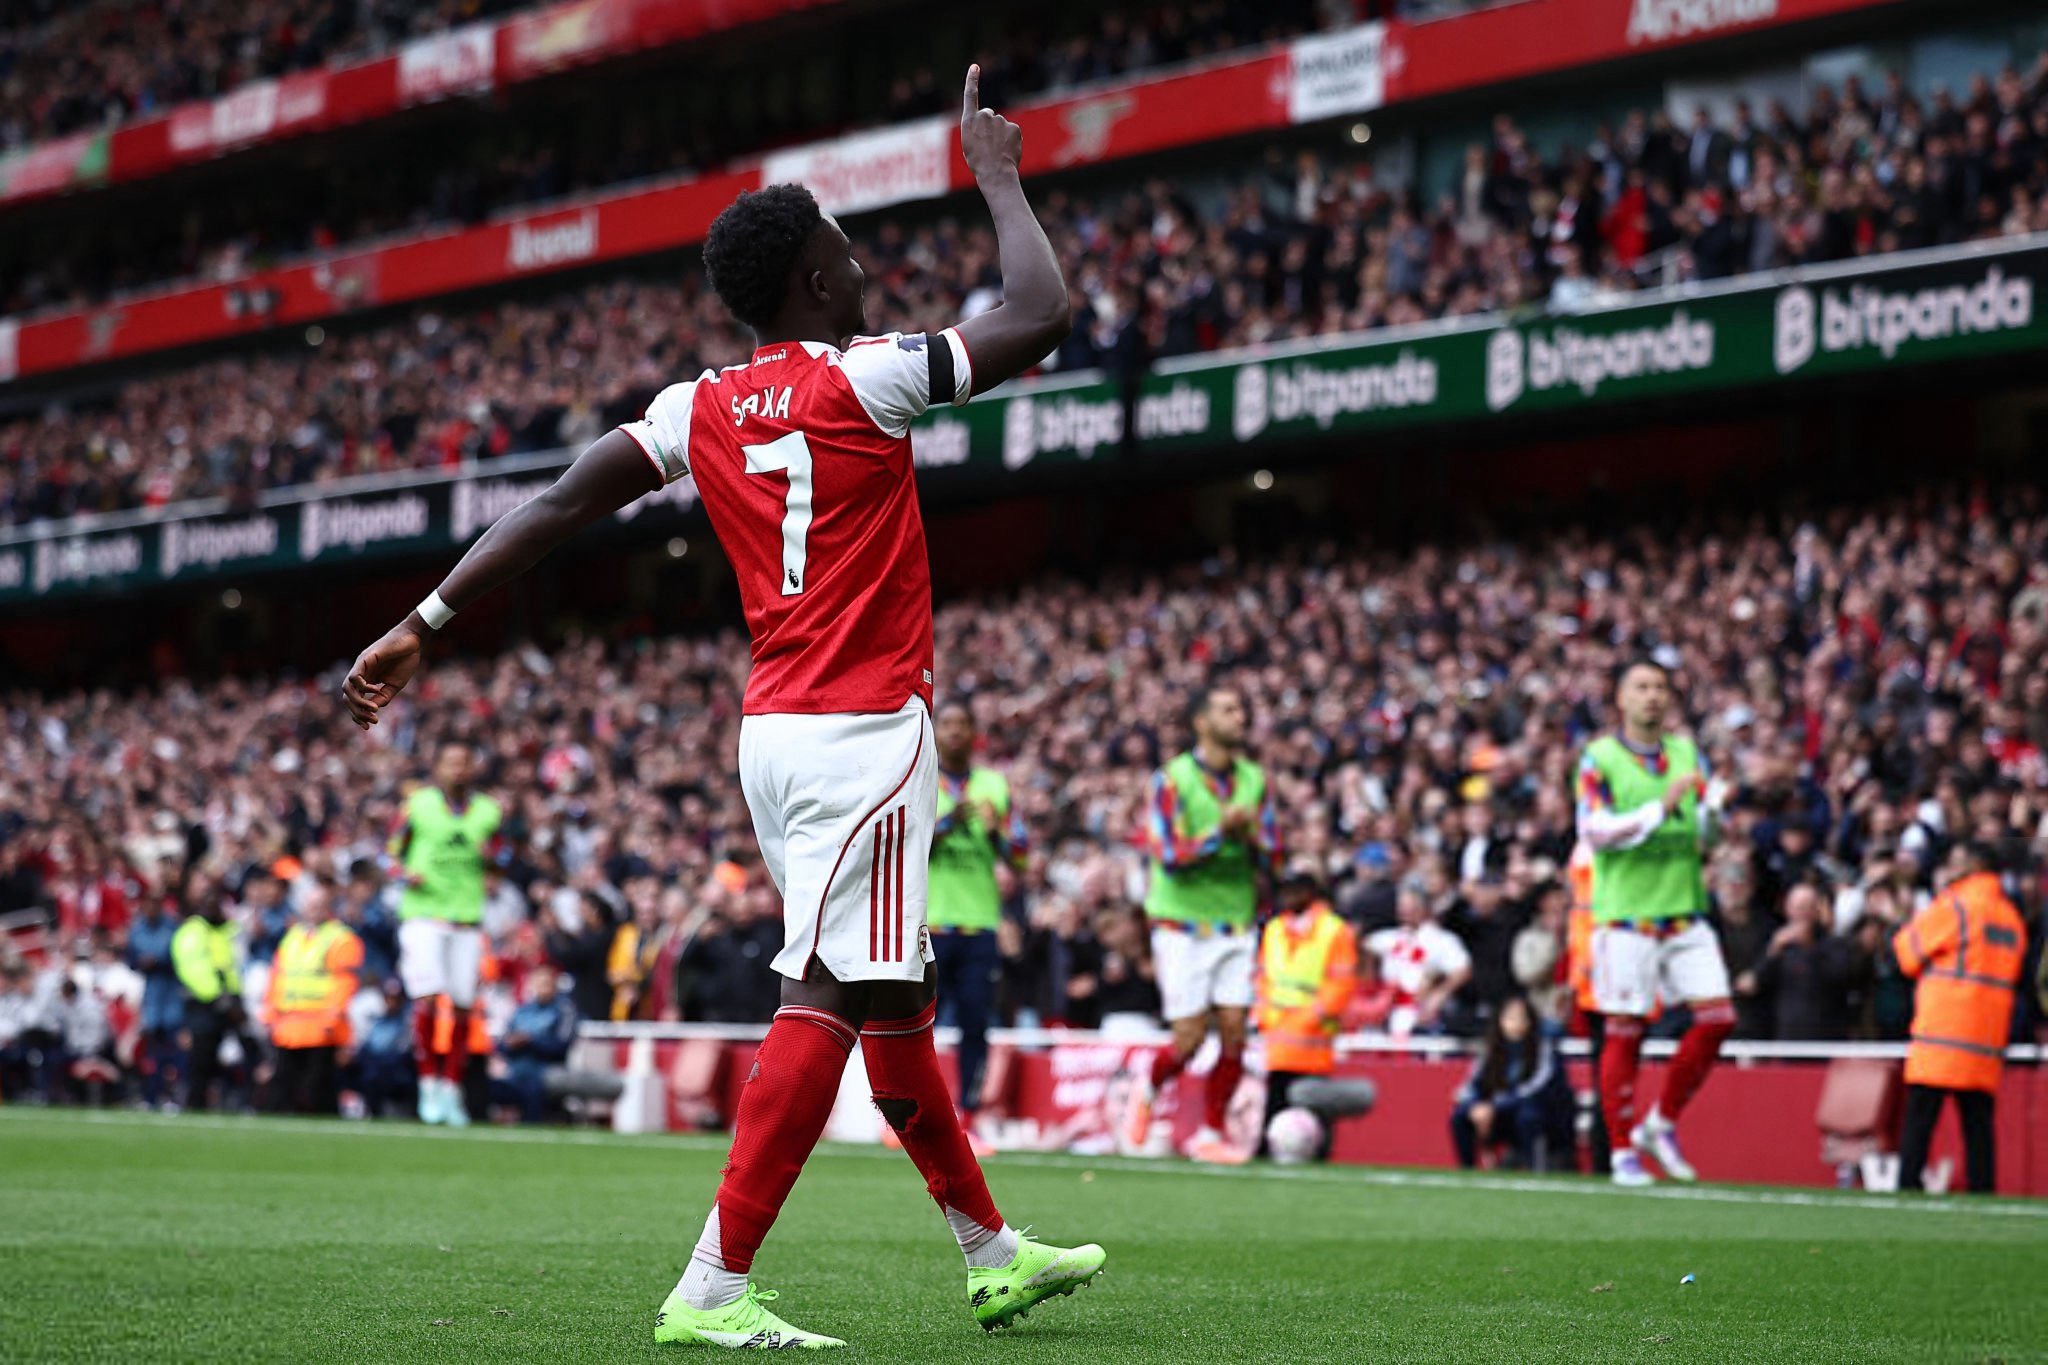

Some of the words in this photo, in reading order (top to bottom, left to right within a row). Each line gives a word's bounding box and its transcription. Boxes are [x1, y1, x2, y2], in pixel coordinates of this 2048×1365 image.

[1529, 312, 1714, 394] bitpanda
[1822, 265, 2032, 359] bitpanda
[753, 348, 787, 368] Arsenal
[742, 430, 814, 596] 7
